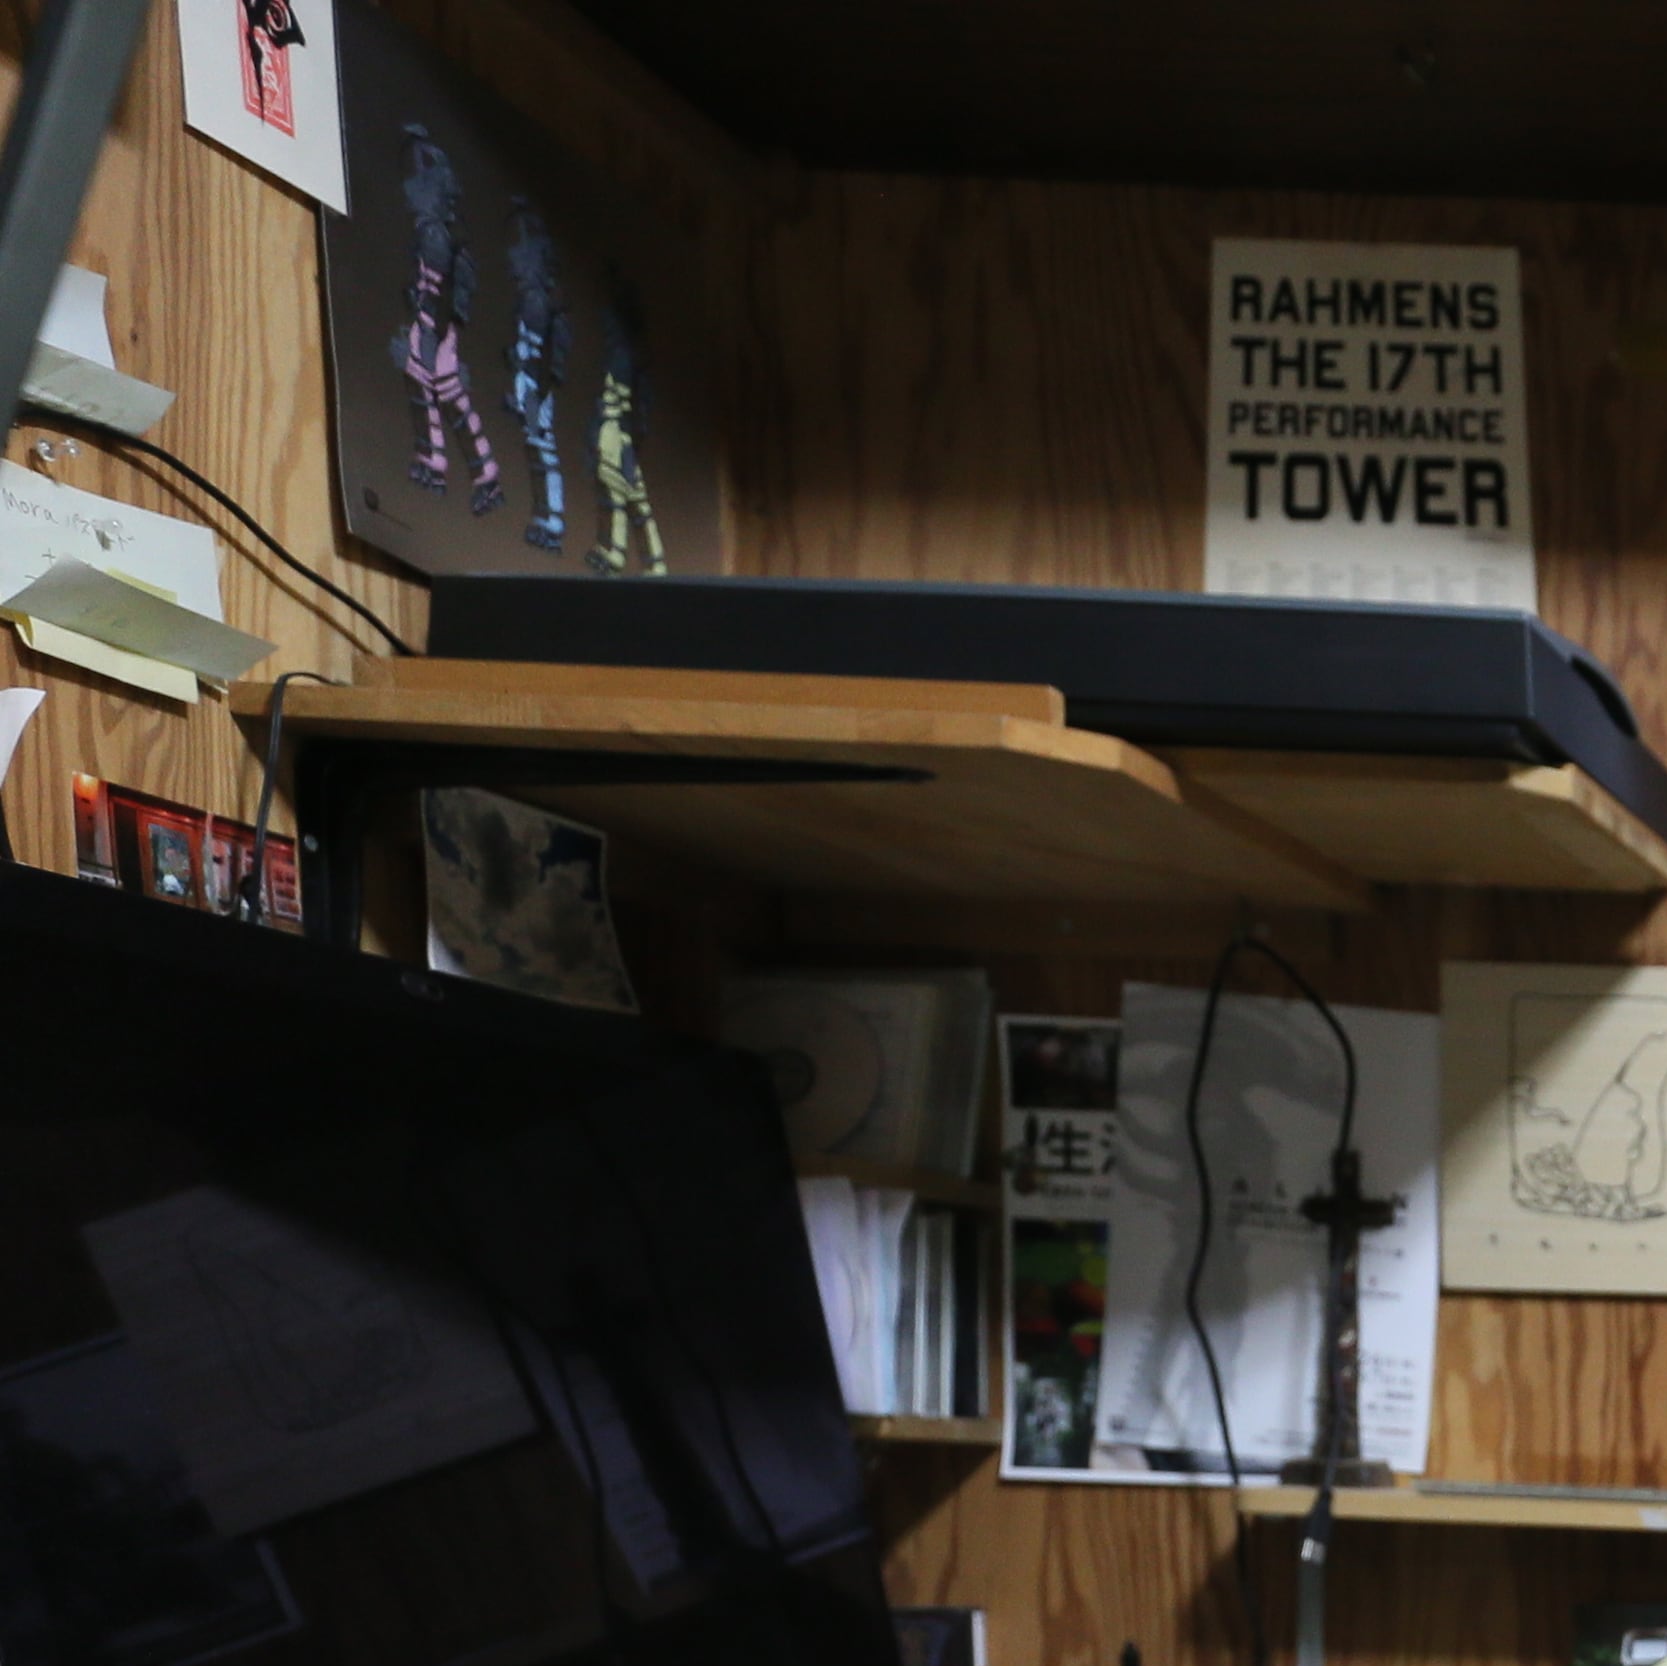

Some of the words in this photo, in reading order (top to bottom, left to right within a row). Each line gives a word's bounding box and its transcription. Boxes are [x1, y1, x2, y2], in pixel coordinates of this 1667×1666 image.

[1230, 275, 1500, 330] RAHMENS
[1231, 336, 1345, 389] THE
[1367, 341, 1501, 394] 17TH
[1227, 401, 1505, 444] PERFORMANCE
[1228, 451, 1509, 529] TOWER
